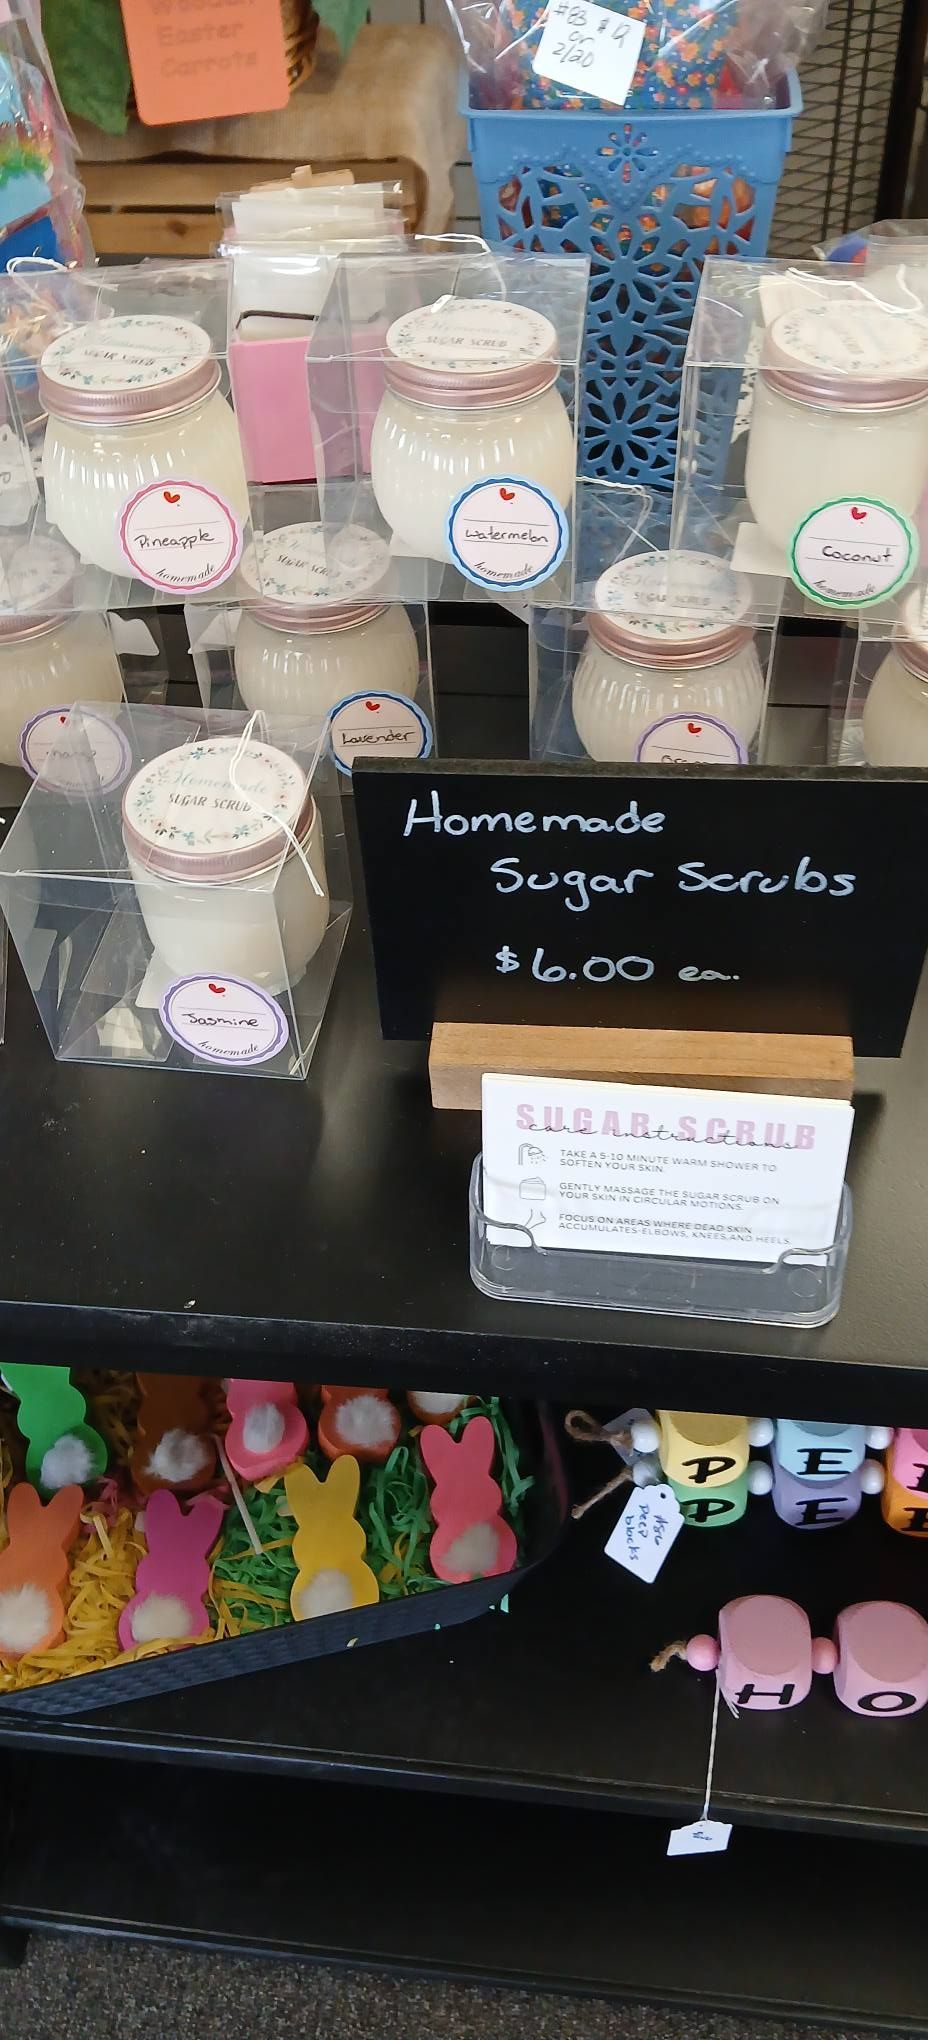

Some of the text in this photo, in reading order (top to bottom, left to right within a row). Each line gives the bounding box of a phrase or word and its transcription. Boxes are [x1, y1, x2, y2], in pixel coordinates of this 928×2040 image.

[157, 22, 243, 47] Easter
[160, 50, 257, 78] Carrots
[134, 528, 215, 549] Pineapple
[822, 545, 892, 563] Coconut
[156, 563, 215, 582] homemade
[474, 561, 534, 579] homemade
[342, 729, 415, 745] Lavender
[168, 793, 252, 812] SUGAR SCRUB
[403, 790, 666, 836] Homemade
[490, 856, 857, 912] Sugar Scrubs
[677, 965, 740, 982] ea.
[182, 1013, 259, 1027] Jasmine
[199, 1040, 259, 1056] homemade
[516, 1103, 816, 1150] SUGAR SCRUB
[528, 1123, 802, 1150] care instructions
[560, 1149, 777, 1172] TAKE A 5-10 MINUTE WARM SHOWER TO
[560, 1158, 602, 1168] SOFTEN
[605, 1161, 635, 1171] YOUR
[559, 1190, 589, 1199] YOUR
[592, 1193, 616, 1201] SKIN
[619, 1195, 631, 1203] IN
[633, 1196, 688, 1207] CIRCULAR
[560, 1182, 780, 1205] GENTLY MASSAGE THE SUGAR SCRUB ON
[559, 1213, 752, 1234] FOCUS ON AREAS WHERE DEAD SKIN
[625, 1515, 641, 1561] blocks
